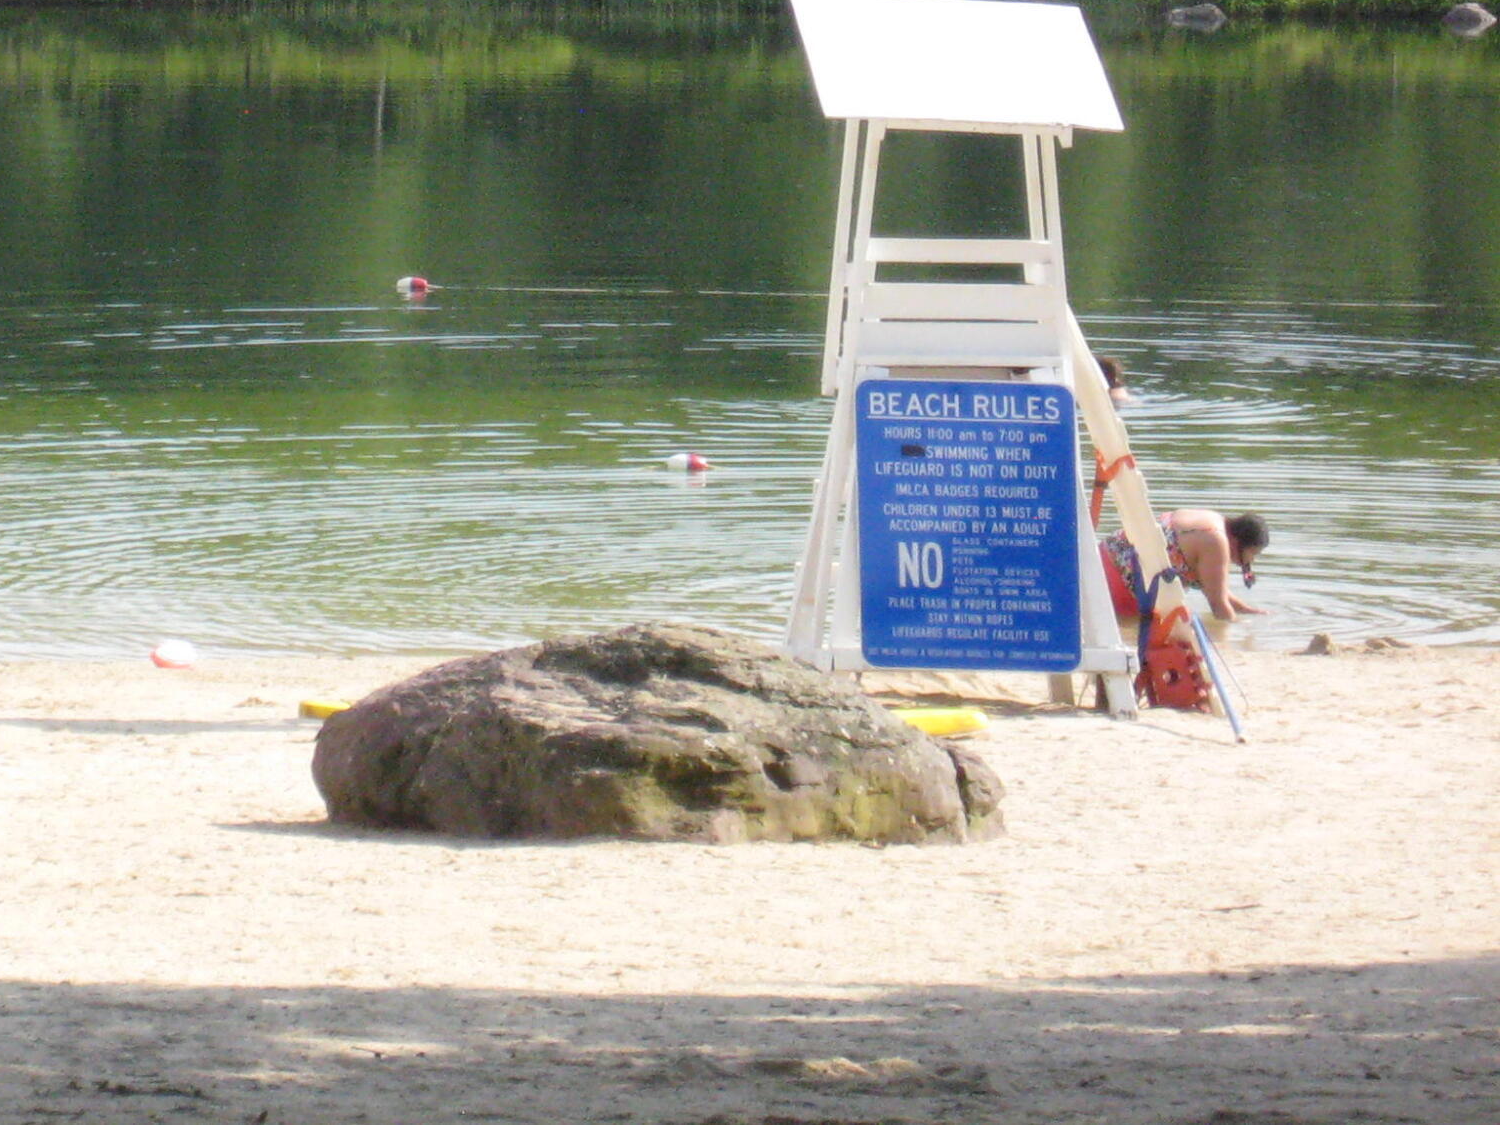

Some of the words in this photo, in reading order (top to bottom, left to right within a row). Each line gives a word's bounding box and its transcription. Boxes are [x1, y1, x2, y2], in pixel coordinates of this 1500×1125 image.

[869, 392, 960, 417] BEACH
[973, 394, 1060, 420] RULES
[884, 427, 922, 439] HOURS
[959, 432, 976, 441] am
[982, 430, 994, 441] to
[1000, 429, 1023, 443] 7:00
[1029, 433, 1047, 444] pm
[925, 446, 988, 459] SWIMMING
[996, 447, 1031, 461] WHEN
[875, 463, 944, 476] LIFEGUARD
[951, 465, 963, 477] IS
[969, 465, 993, 478] NOT
[1001, 465, 1017, 479] ON
[1025, 467, 1057, 480] DUTY
[935, 485, 979, 497] BADGES
[985, 486, 1038, 499] REQUIRED
[883, 503, 937, 516] CHILDREN
[943, 505, 980, 518] UNDER
[986, 507, 996, 517] 13
[1002, 507, 1030, 518] MUST
[1038, 508, 1052, 519] BE
[889, 520, 967, 532] ACCOMPANIED
[972, 522, 985, 533] BY
[991, 523, 1006, 534] AN
[1013, 523, 1047, 536] ADULT
[898, 541, 943, 589] NO
